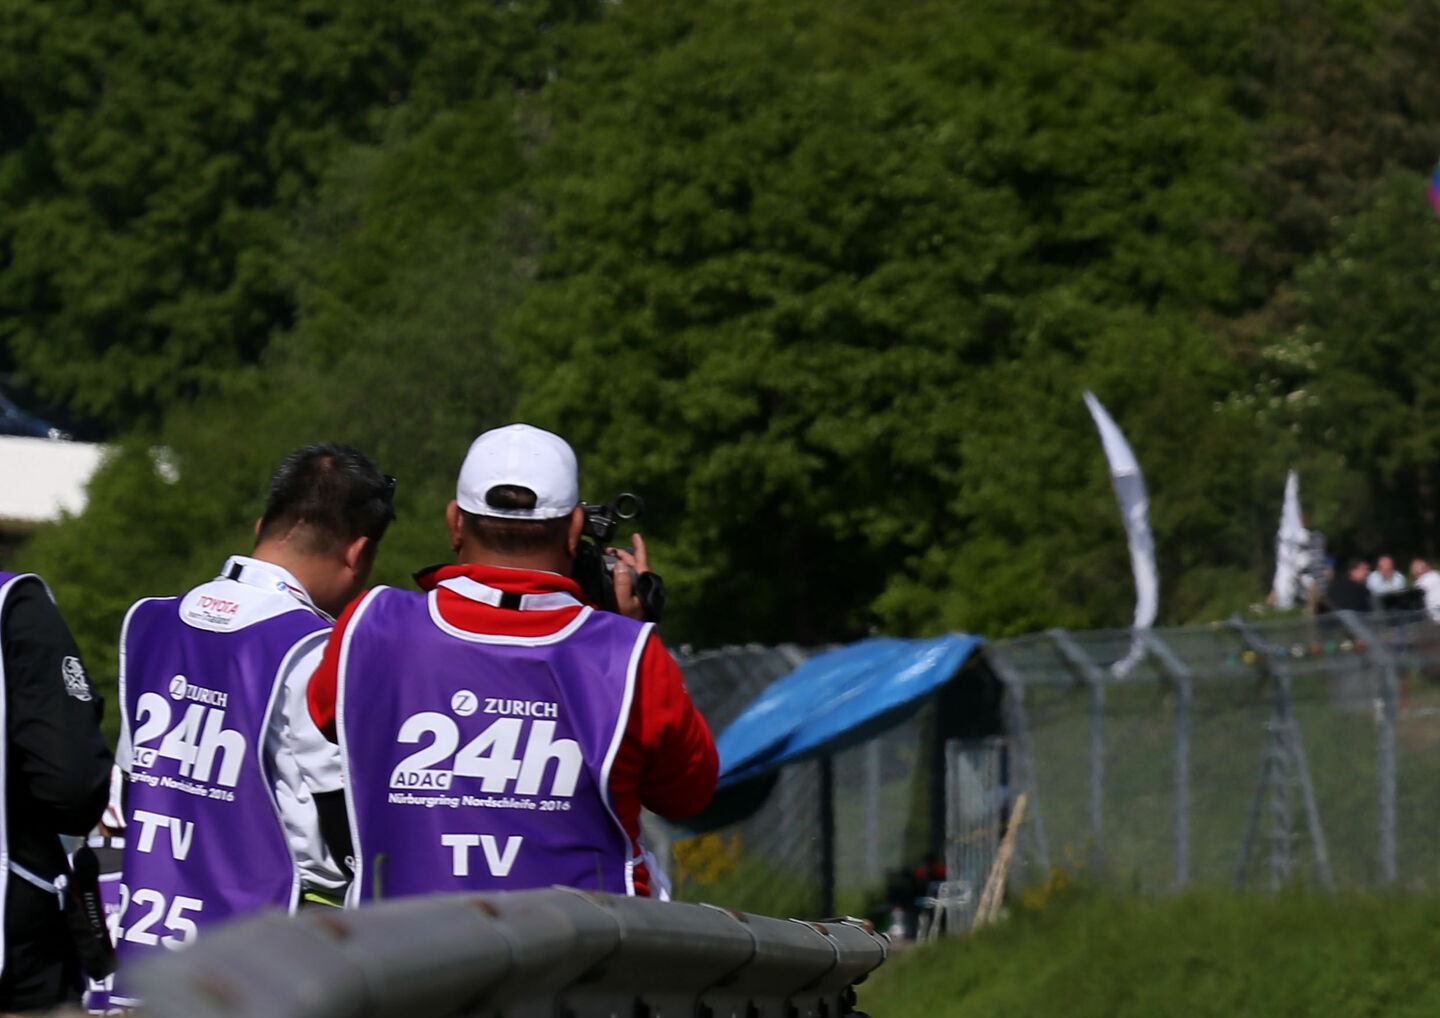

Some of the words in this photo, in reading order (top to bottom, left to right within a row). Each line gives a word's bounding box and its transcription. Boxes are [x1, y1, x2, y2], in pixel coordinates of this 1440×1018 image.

[187, 683, 228, 708] ZURICH
[483, 698, 558, 718] ZURICH
[133, 692, 246, 787] 24h
[390, 711, 583, 798] 24h
[394, 771, 447, 788] ADAC
[388, 793, 459, 809] Nürburgring
[462, 795, 537, 811] Nordschleife
[539, 799, 571, 812] 2016
[133, 809, 194, 861] TV
[441, 834, 524, 877] TV
